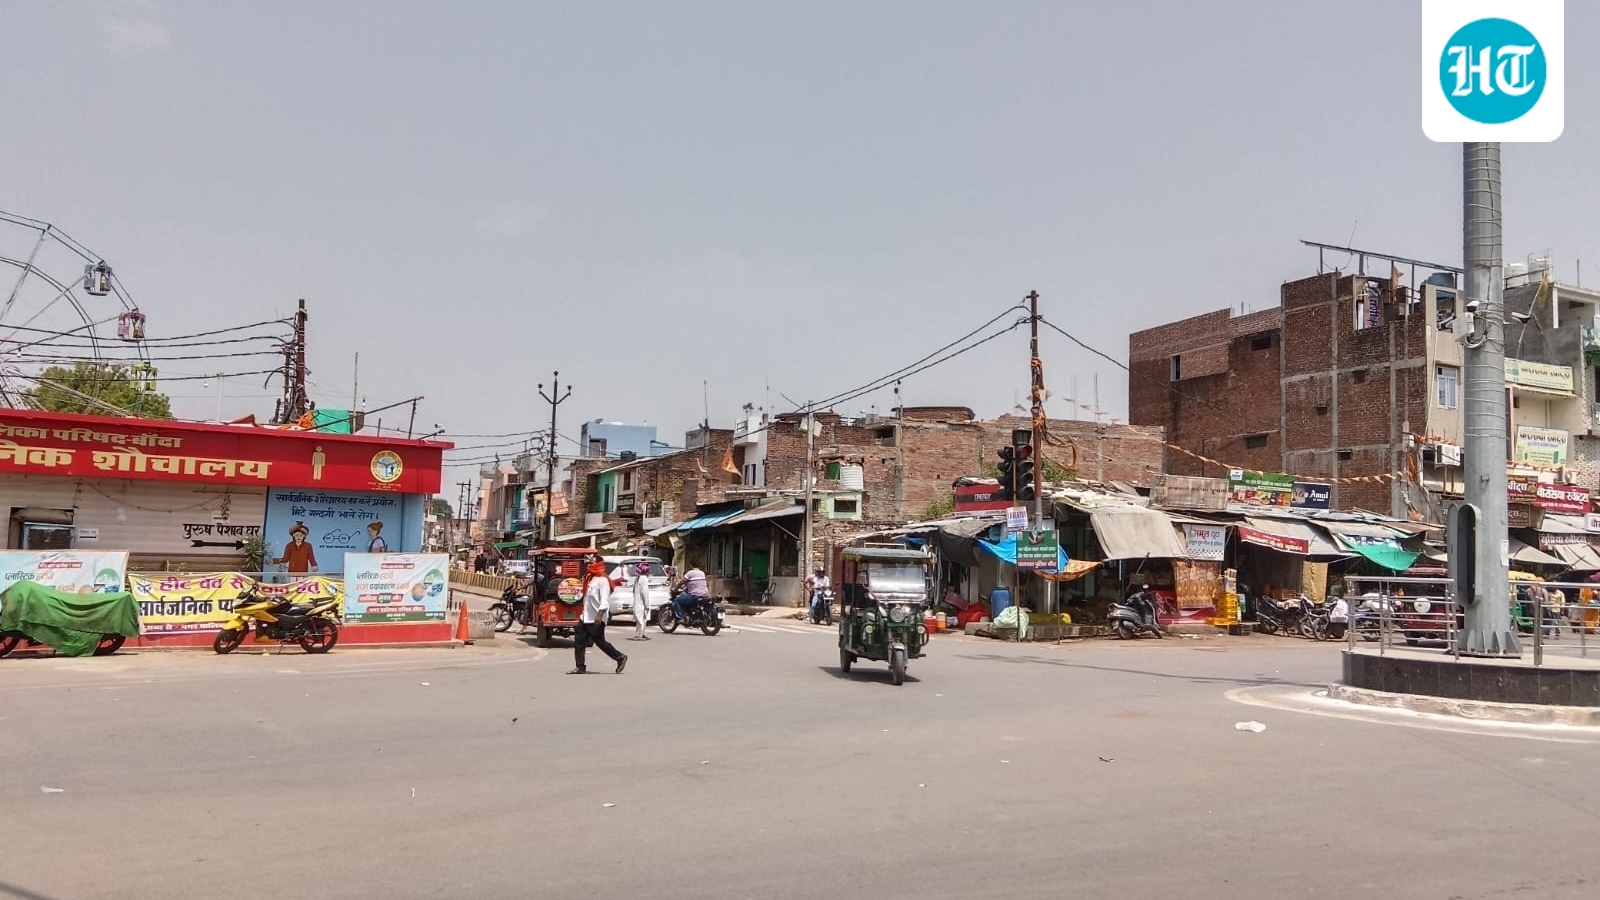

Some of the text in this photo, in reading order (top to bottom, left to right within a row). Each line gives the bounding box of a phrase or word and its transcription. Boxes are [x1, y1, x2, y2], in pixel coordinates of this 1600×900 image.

[92, 447, 272, 479] शौचालय
[1309, 490, 1329, 499] Amul
[139, 596, 213, 616] सार्वजनिक
